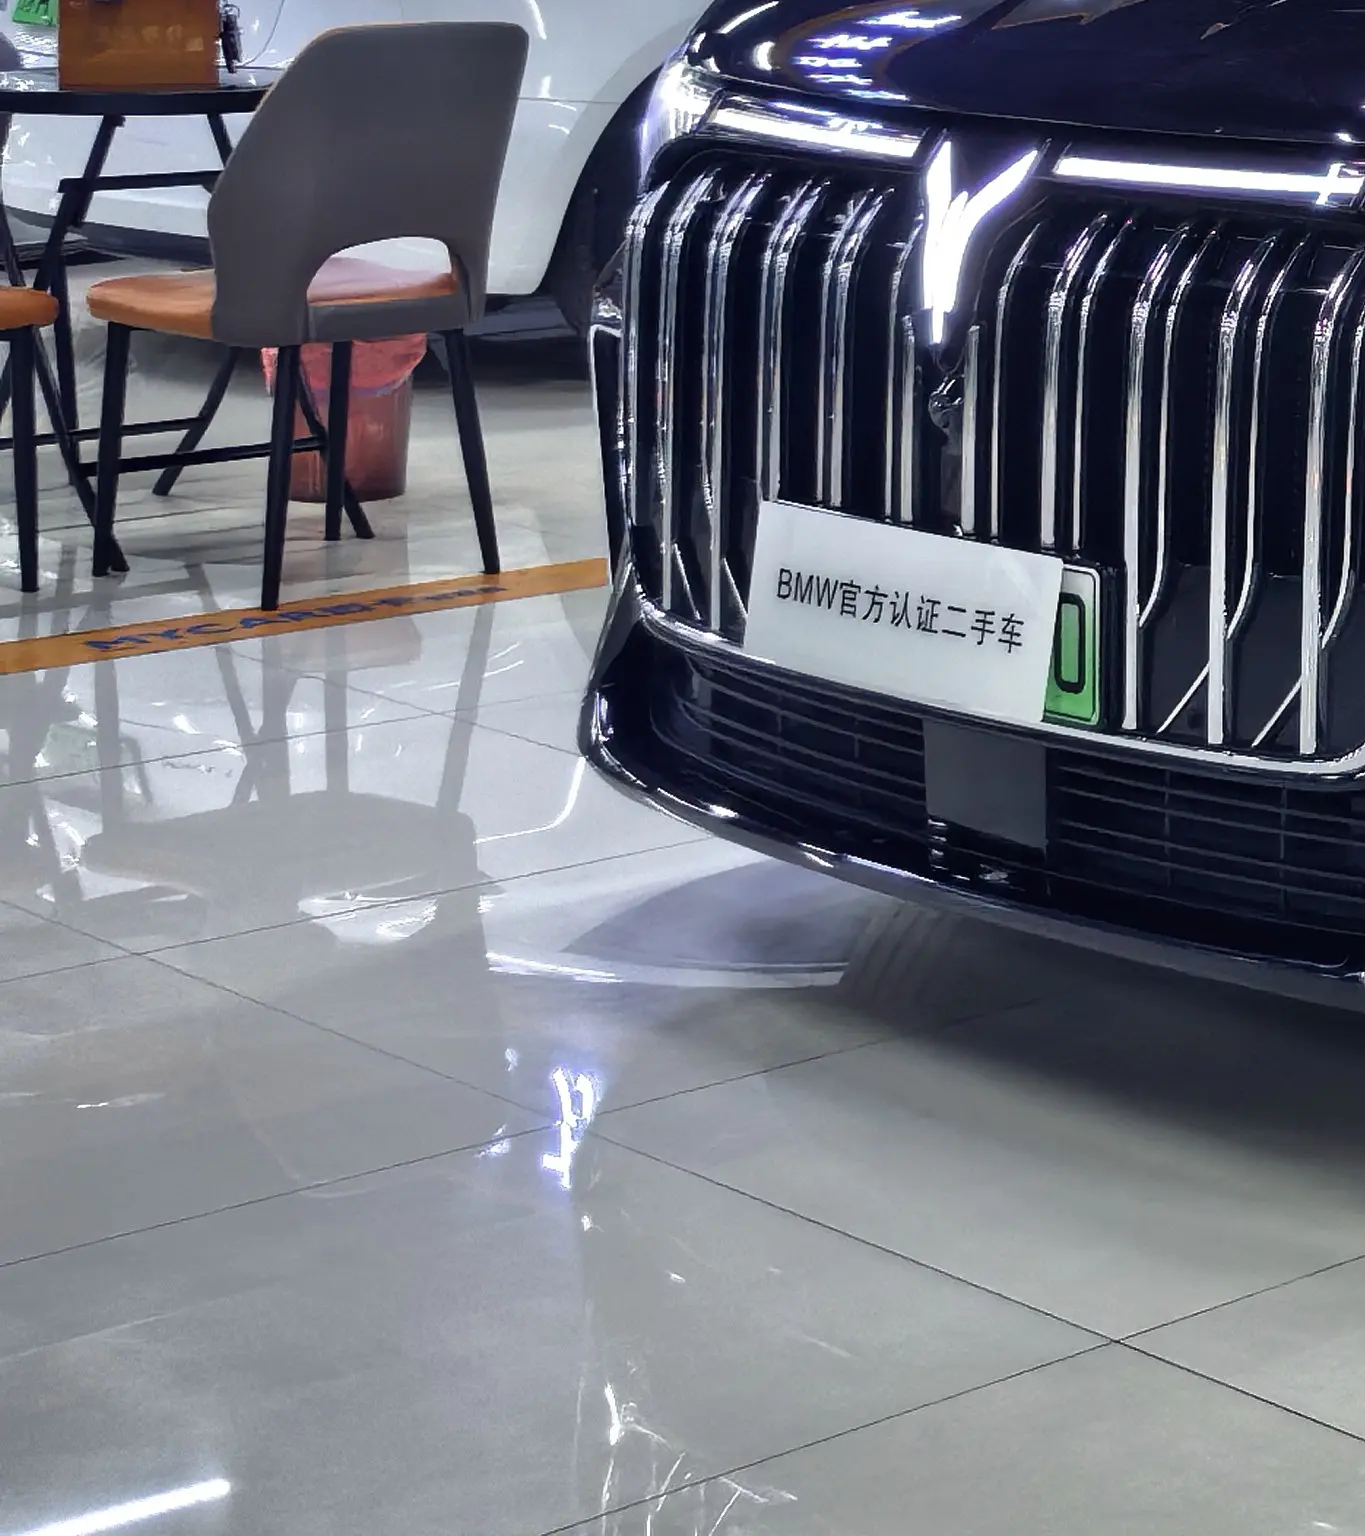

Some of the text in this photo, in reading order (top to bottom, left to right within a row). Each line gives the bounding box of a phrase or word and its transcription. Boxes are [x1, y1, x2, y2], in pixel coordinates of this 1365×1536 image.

[776, 568, 1025, 654] BMW官方认证二手车
